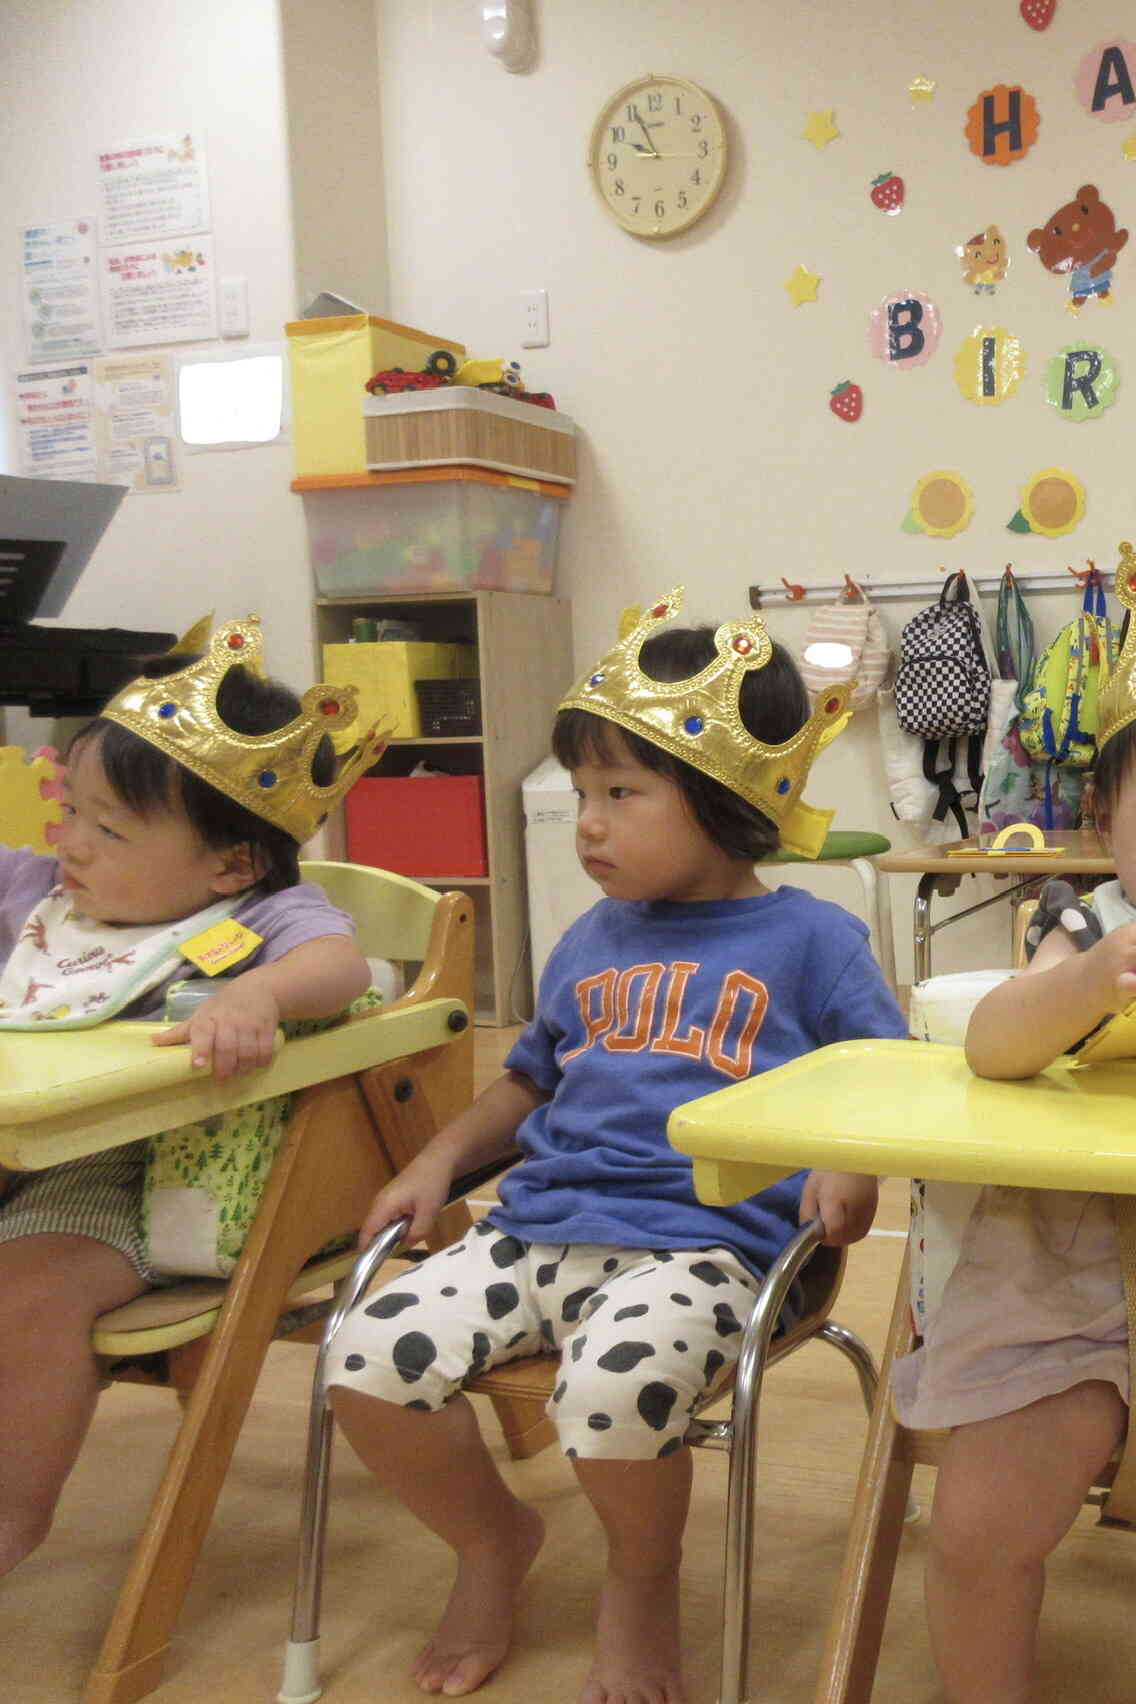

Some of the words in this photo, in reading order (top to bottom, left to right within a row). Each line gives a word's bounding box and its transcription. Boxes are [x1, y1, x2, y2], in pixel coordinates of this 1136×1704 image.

[648, 95, 663, 112] 12
[674, 97, 682, 115] 1
[690, 115, 702, 133] 2
[611, 126, 625, 144] 10
[697, 141, 709, 159] 3
[608, 154, 617, 171] 9
[691, 169, 701, 186] 4
[615, 179, 625, 197] 8
[632, 197, 641, 214] 7
[655, 200, 665, 218] 6
[678, 192, 688, 209] 5
[560, 961, 768, 1080] POLO
